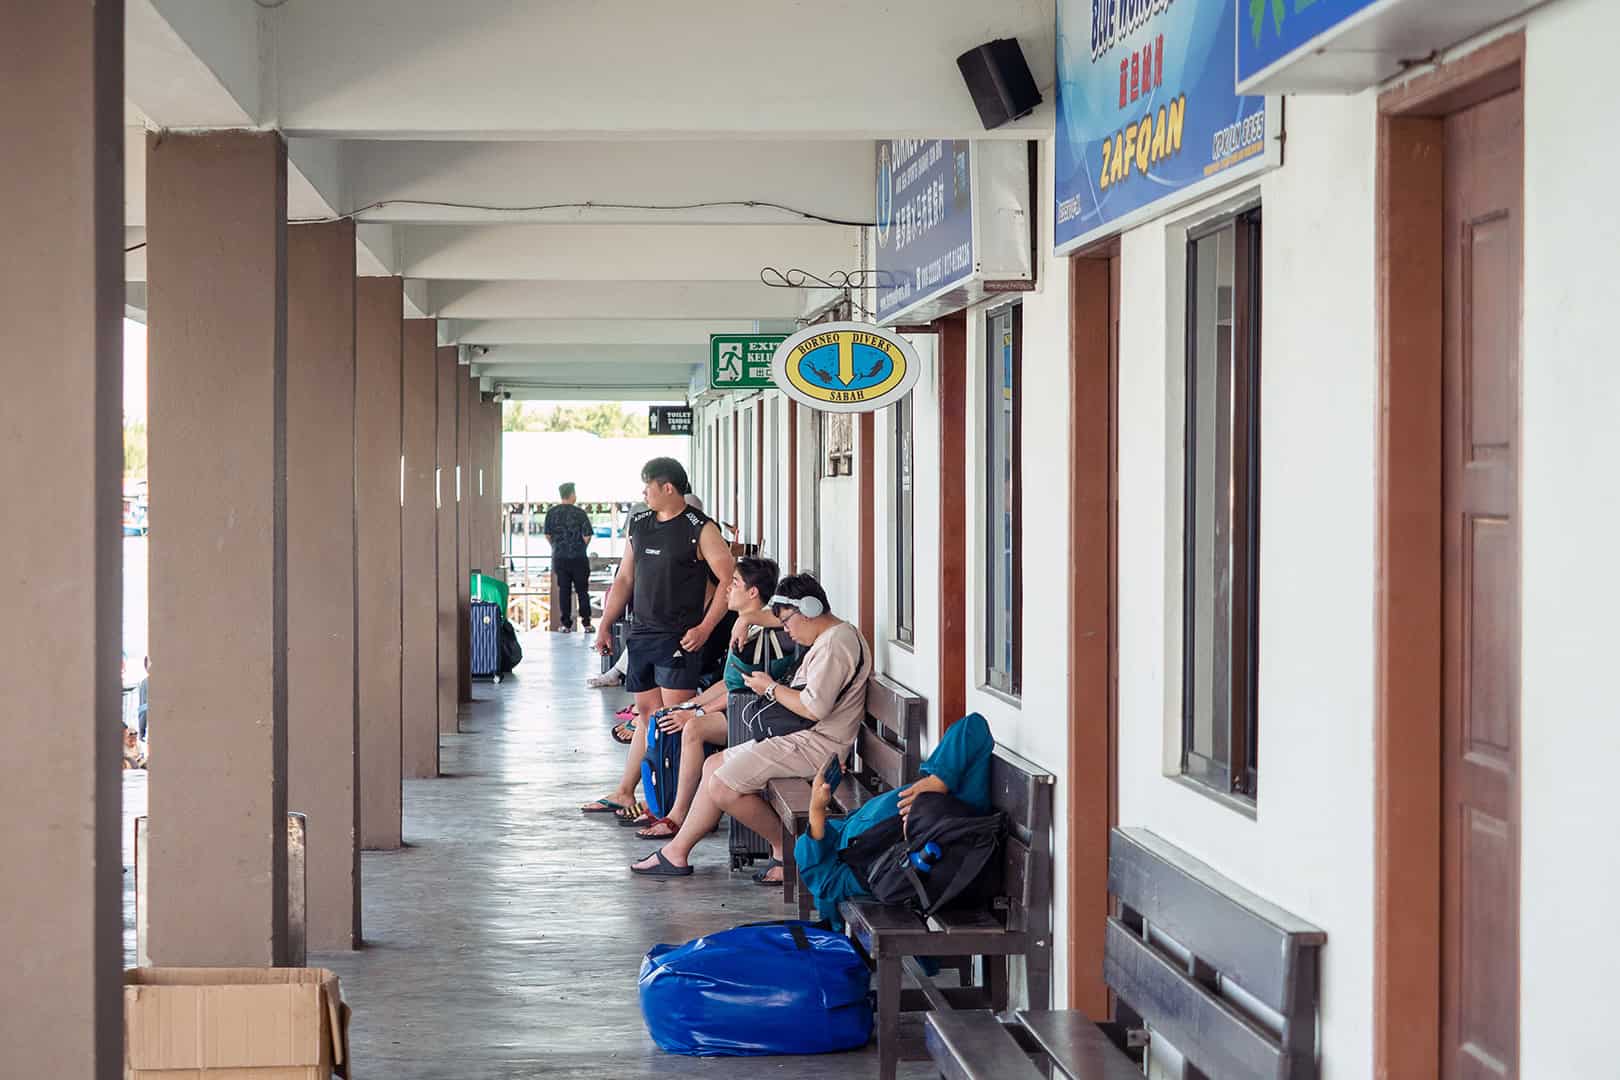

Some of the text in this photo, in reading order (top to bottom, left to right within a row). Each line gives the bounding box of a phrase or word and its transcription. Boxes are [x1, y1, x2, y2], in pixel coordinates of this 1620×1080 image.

[1100, 94, 1186, 190] ZAFQAN
[798, 333, 891, 354] BORNEO DIVERS
[829, 390, 865, 401] SABAH
